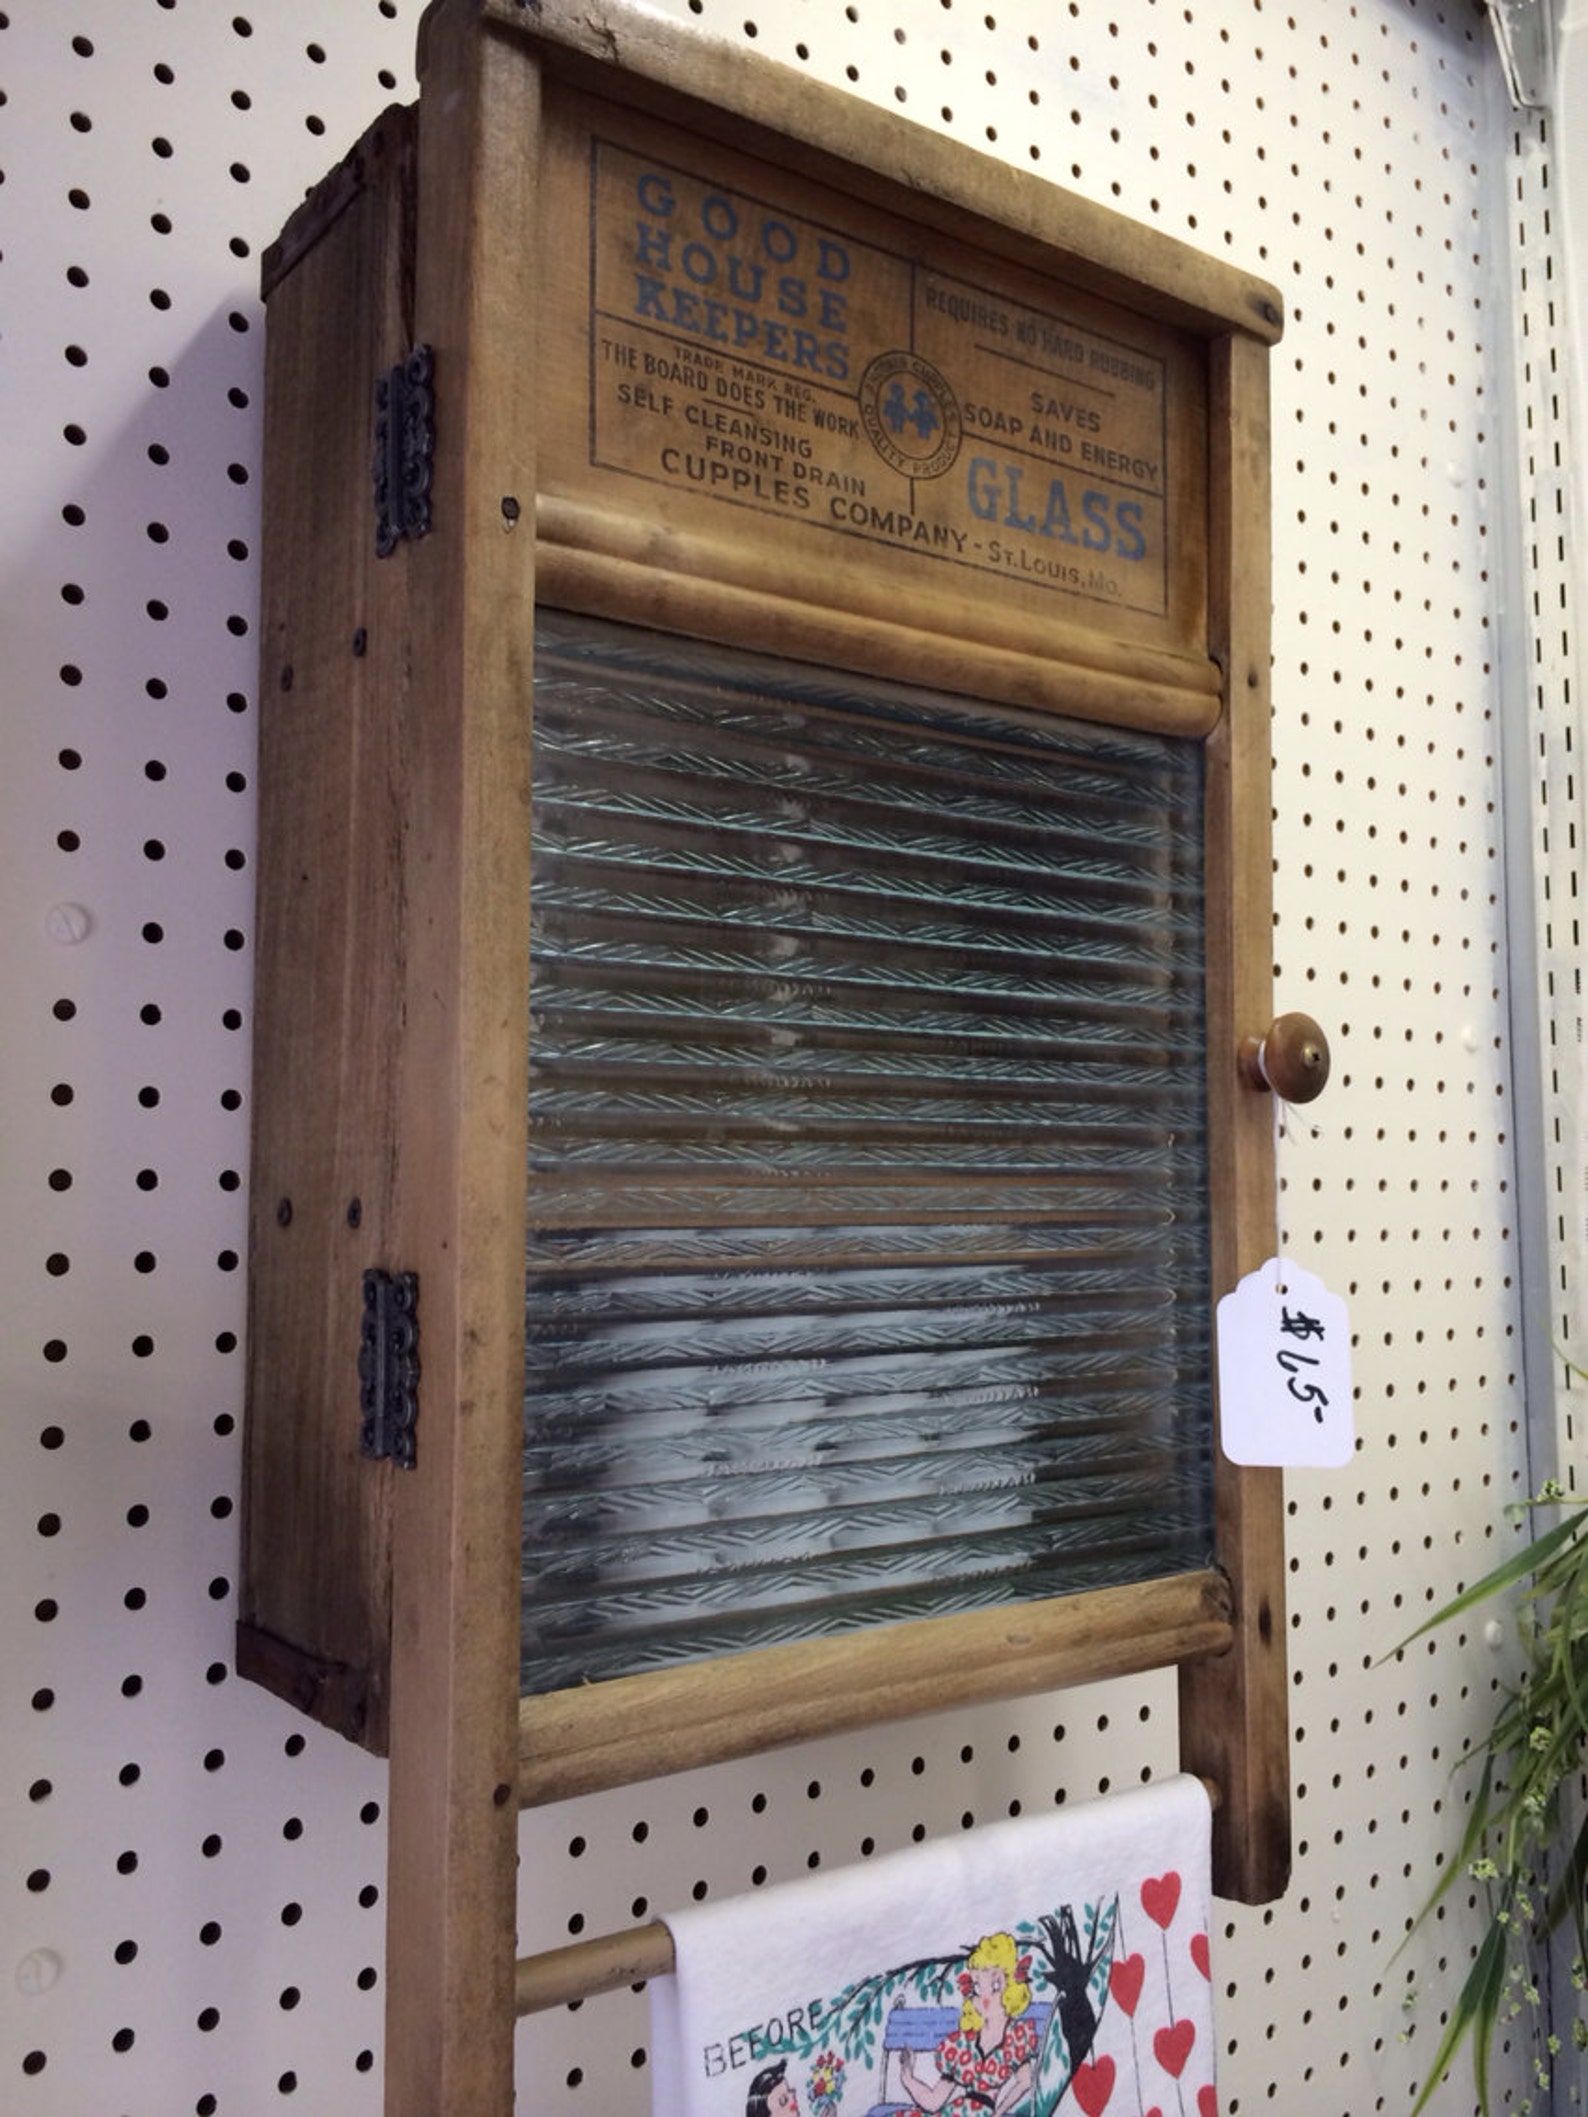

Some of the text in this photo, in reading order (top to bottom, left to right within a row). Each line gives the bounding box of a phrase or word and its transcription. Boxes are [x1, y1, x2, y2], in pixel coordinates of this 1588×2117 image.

[636, 172, 851, 283] GOOD
[635, 221, 848, 334] HOUSE
[925, 286, 1010, 337] REQUIRES
[1016, 319, 1038, 346] NO
[634, 272, 850, 381] KEEPERS
[602, 339, 860, 441] THE BOARD DOES THE WORK
[674, 345, 723, 371] TRADE
[732, 367, 777, 391] MARK
[617, 383, 813, 459] SELF CLEANSING
[964, 402, 1159, 481] SOAP AND ENERGY
[1030, 391, 1102, 433] SAVES
[660, 447, 811, 510] CUPPLES
[705, 434, 866, 497] FRONT DRAIN
[966, 456, 1147, 562] GLASS
[703, 1998, 823, 2078] BEFORE
